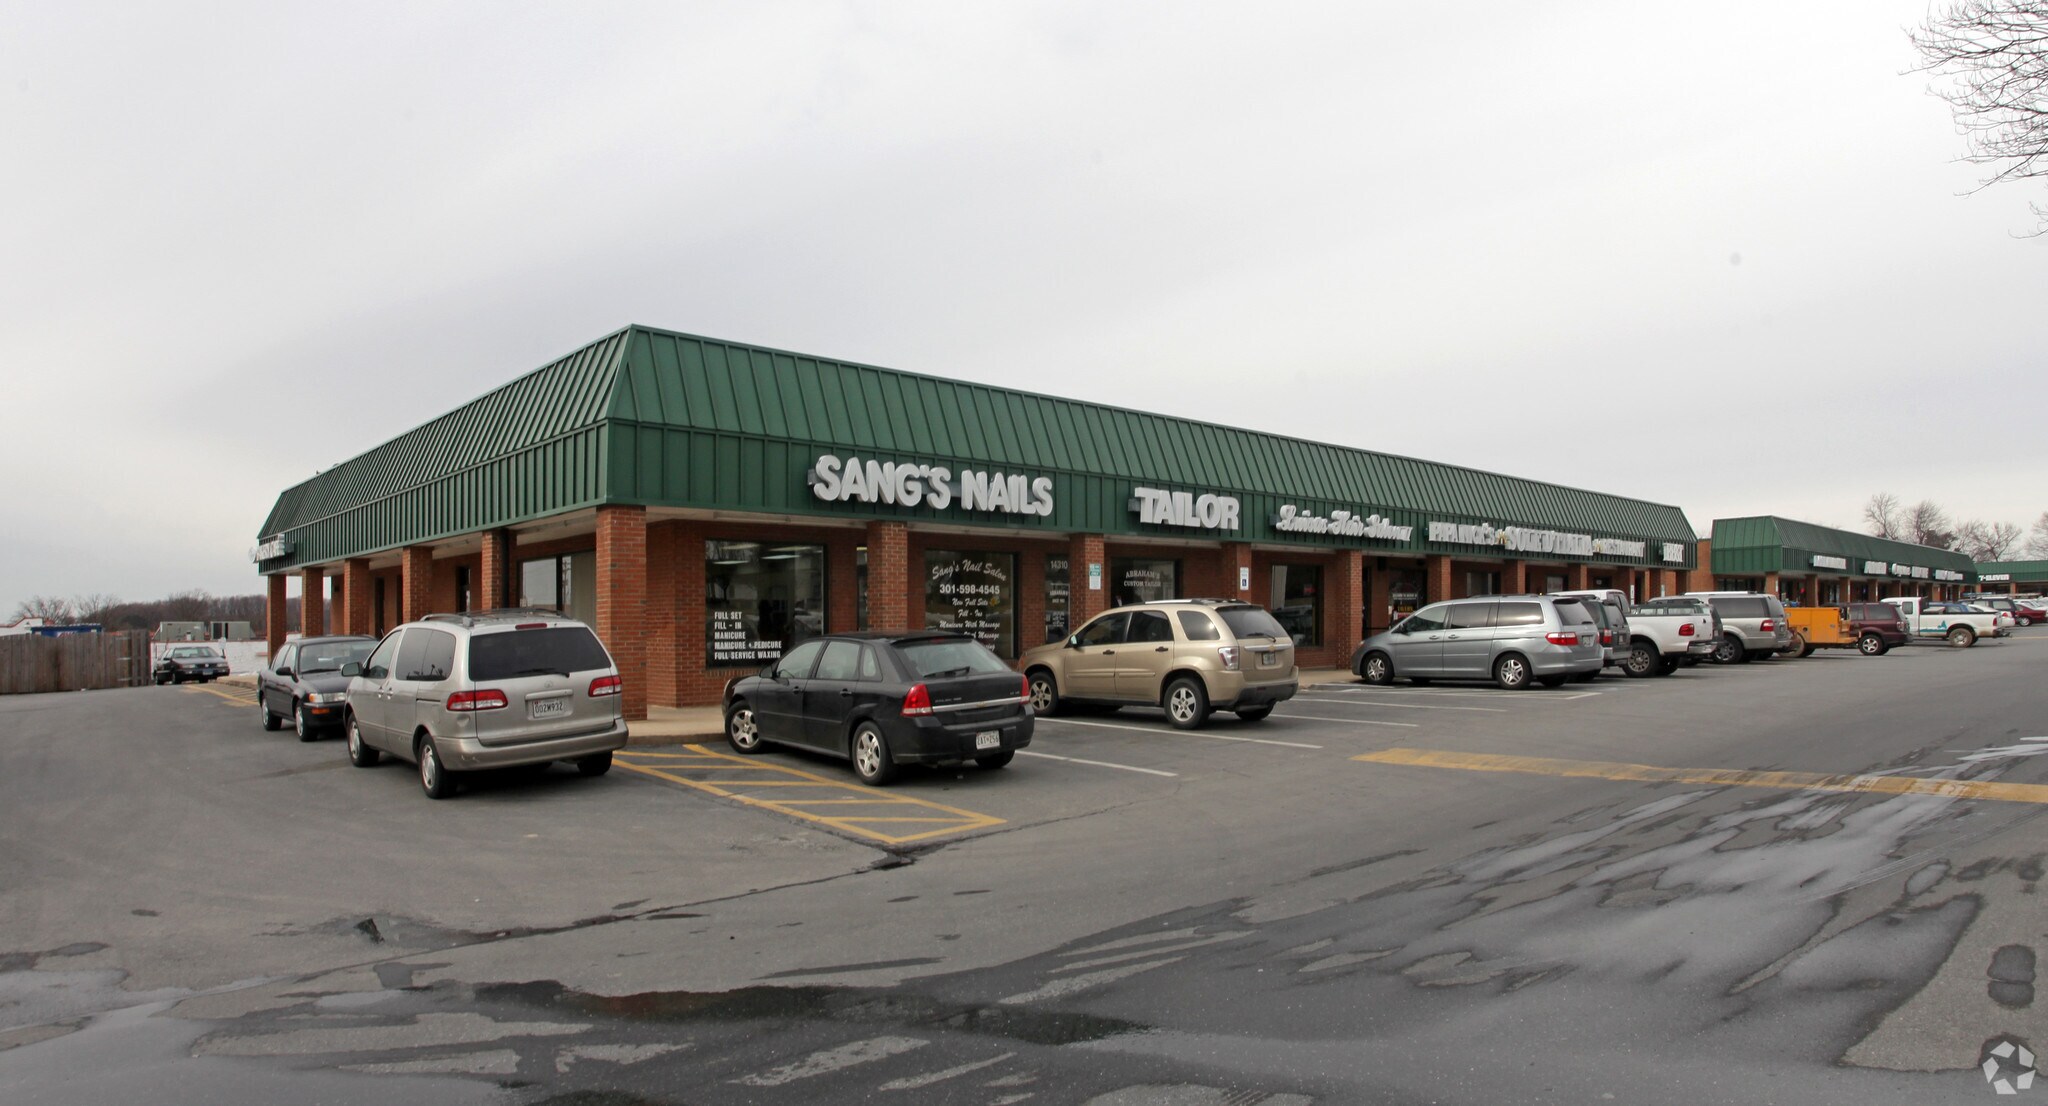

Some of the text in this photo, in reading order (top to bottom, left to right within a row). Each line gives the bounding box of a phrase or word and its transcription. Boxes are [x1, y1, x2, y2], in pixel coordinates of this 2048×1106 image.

[814, 454, 1053, 516] SANG'S NAILS
[1135, 486, 1239, 530] TAILOR
[1428, 521, 1458, 542] PAPA
[1051, 561, 1068, 569] 14310
[932, 559, 1006, 581] Sang's Nail Salon
[940, 584, 1000, 594] 301-598-4545
[965, 598, 976, 606] Full
[714, 611, 742, 620] FULL SET
[714, 621, 726, 630] FILL
[735, 621, 742, 629] IN
[714, 631, 746, 640] MANICURE
[714, 641, 746, 650] MANICURE
[753, 641, 782, 649] PEDICURE
[714, 650, 781, 660] FULL SERVICE WAXING
